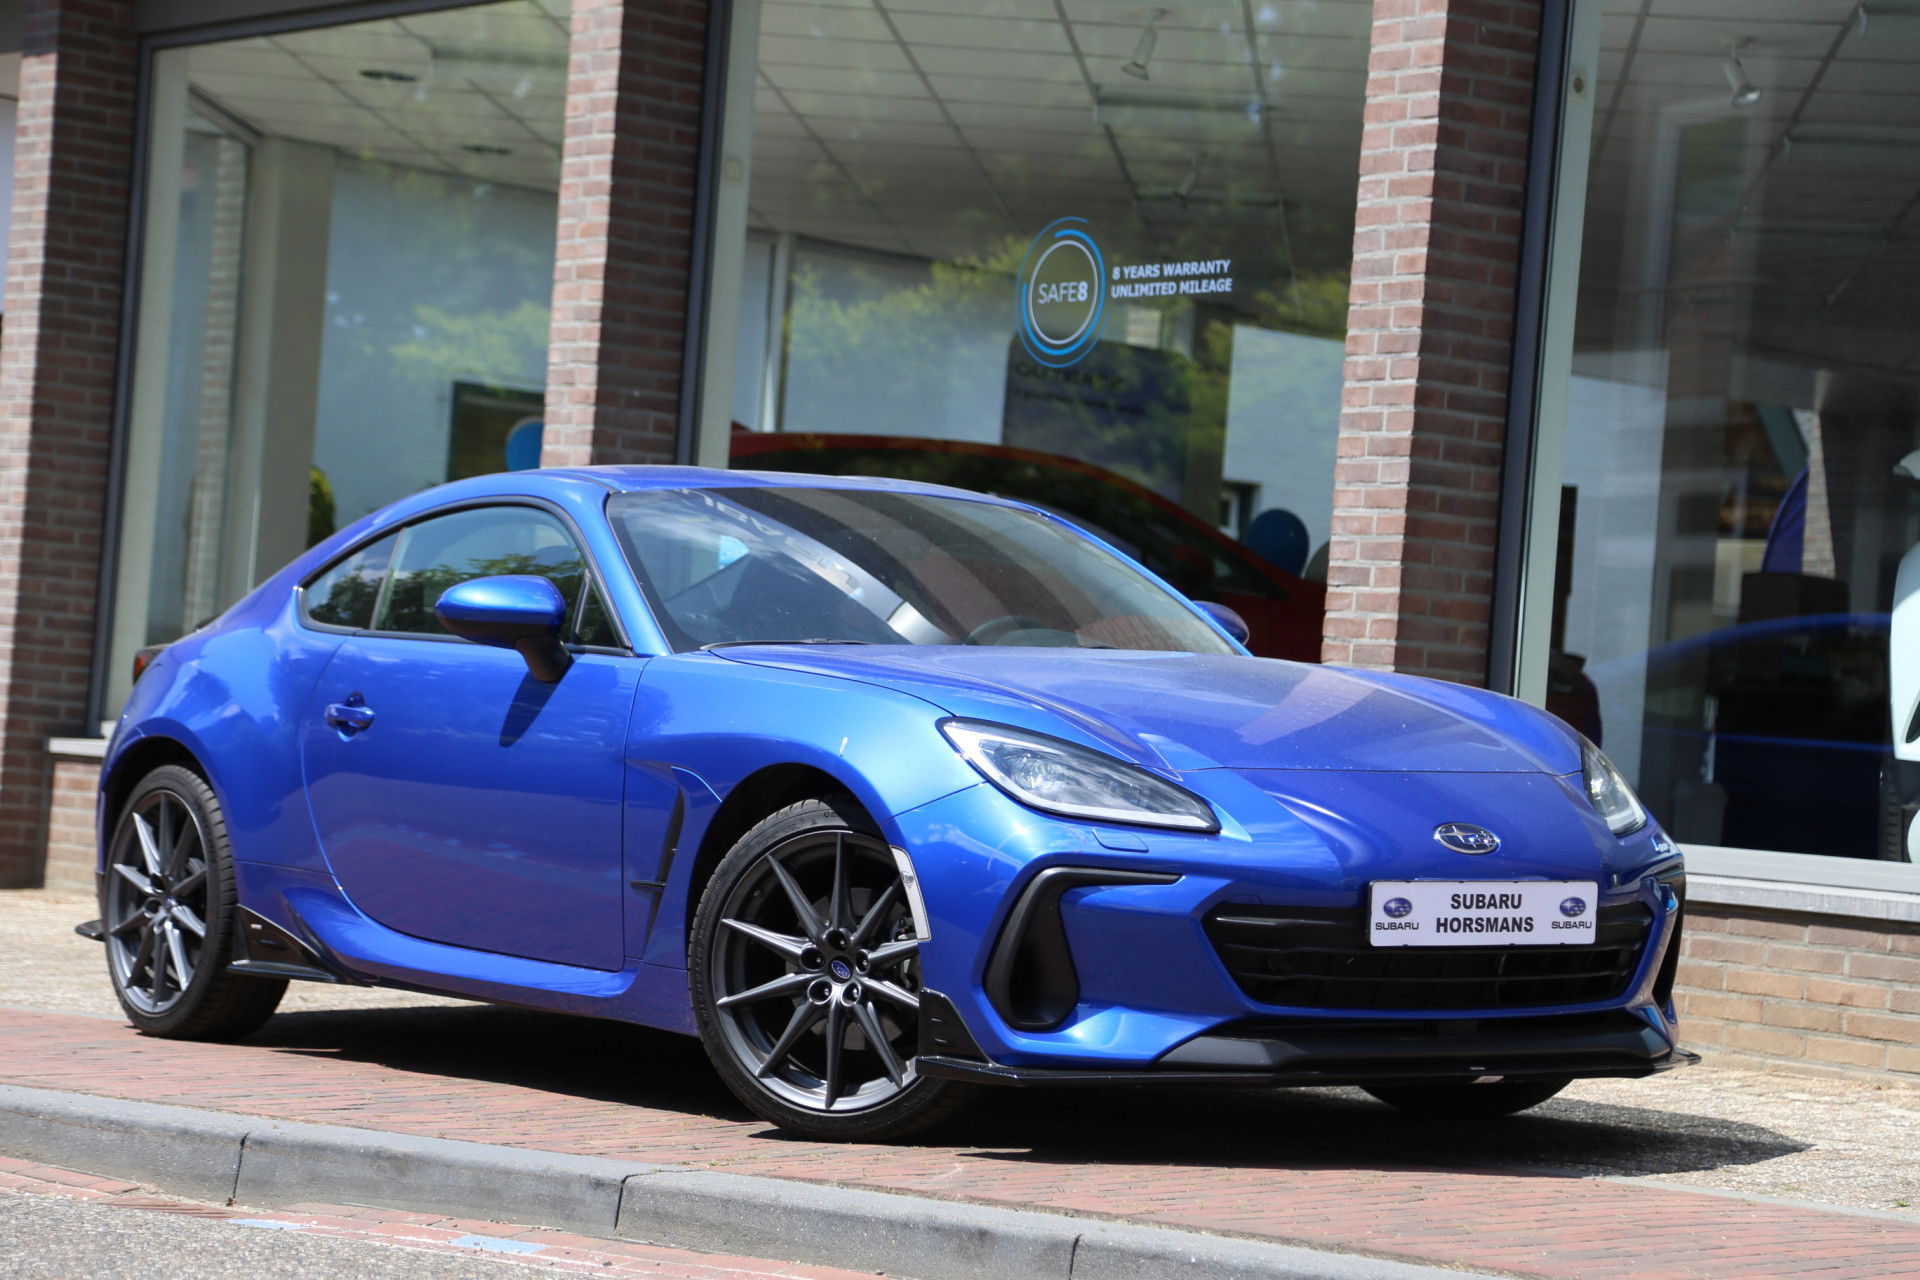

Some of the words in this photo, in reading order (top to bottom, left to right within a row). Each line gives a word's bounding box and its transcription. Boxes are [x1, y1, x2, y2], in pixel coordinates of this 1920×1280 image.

[1112, 265, 1121, 281] 8
[1123, 263, 1161, 279] YEARS
[1163, 259, 1231, 278] WARRANTY
[1038, 281, 1089, 304] SAFE8
[1111, 281, 1177, 299] UNLIMITED
[1179, 278, 1233, 295] MILEAGE
[1450, 893, 1523, 910] SUBARU
[1375, 921, 1420, 931] SUBARU
[1436, 916, 1534, 933] HORSMANS
[1551, 920, 1592, 930] SUBARU
